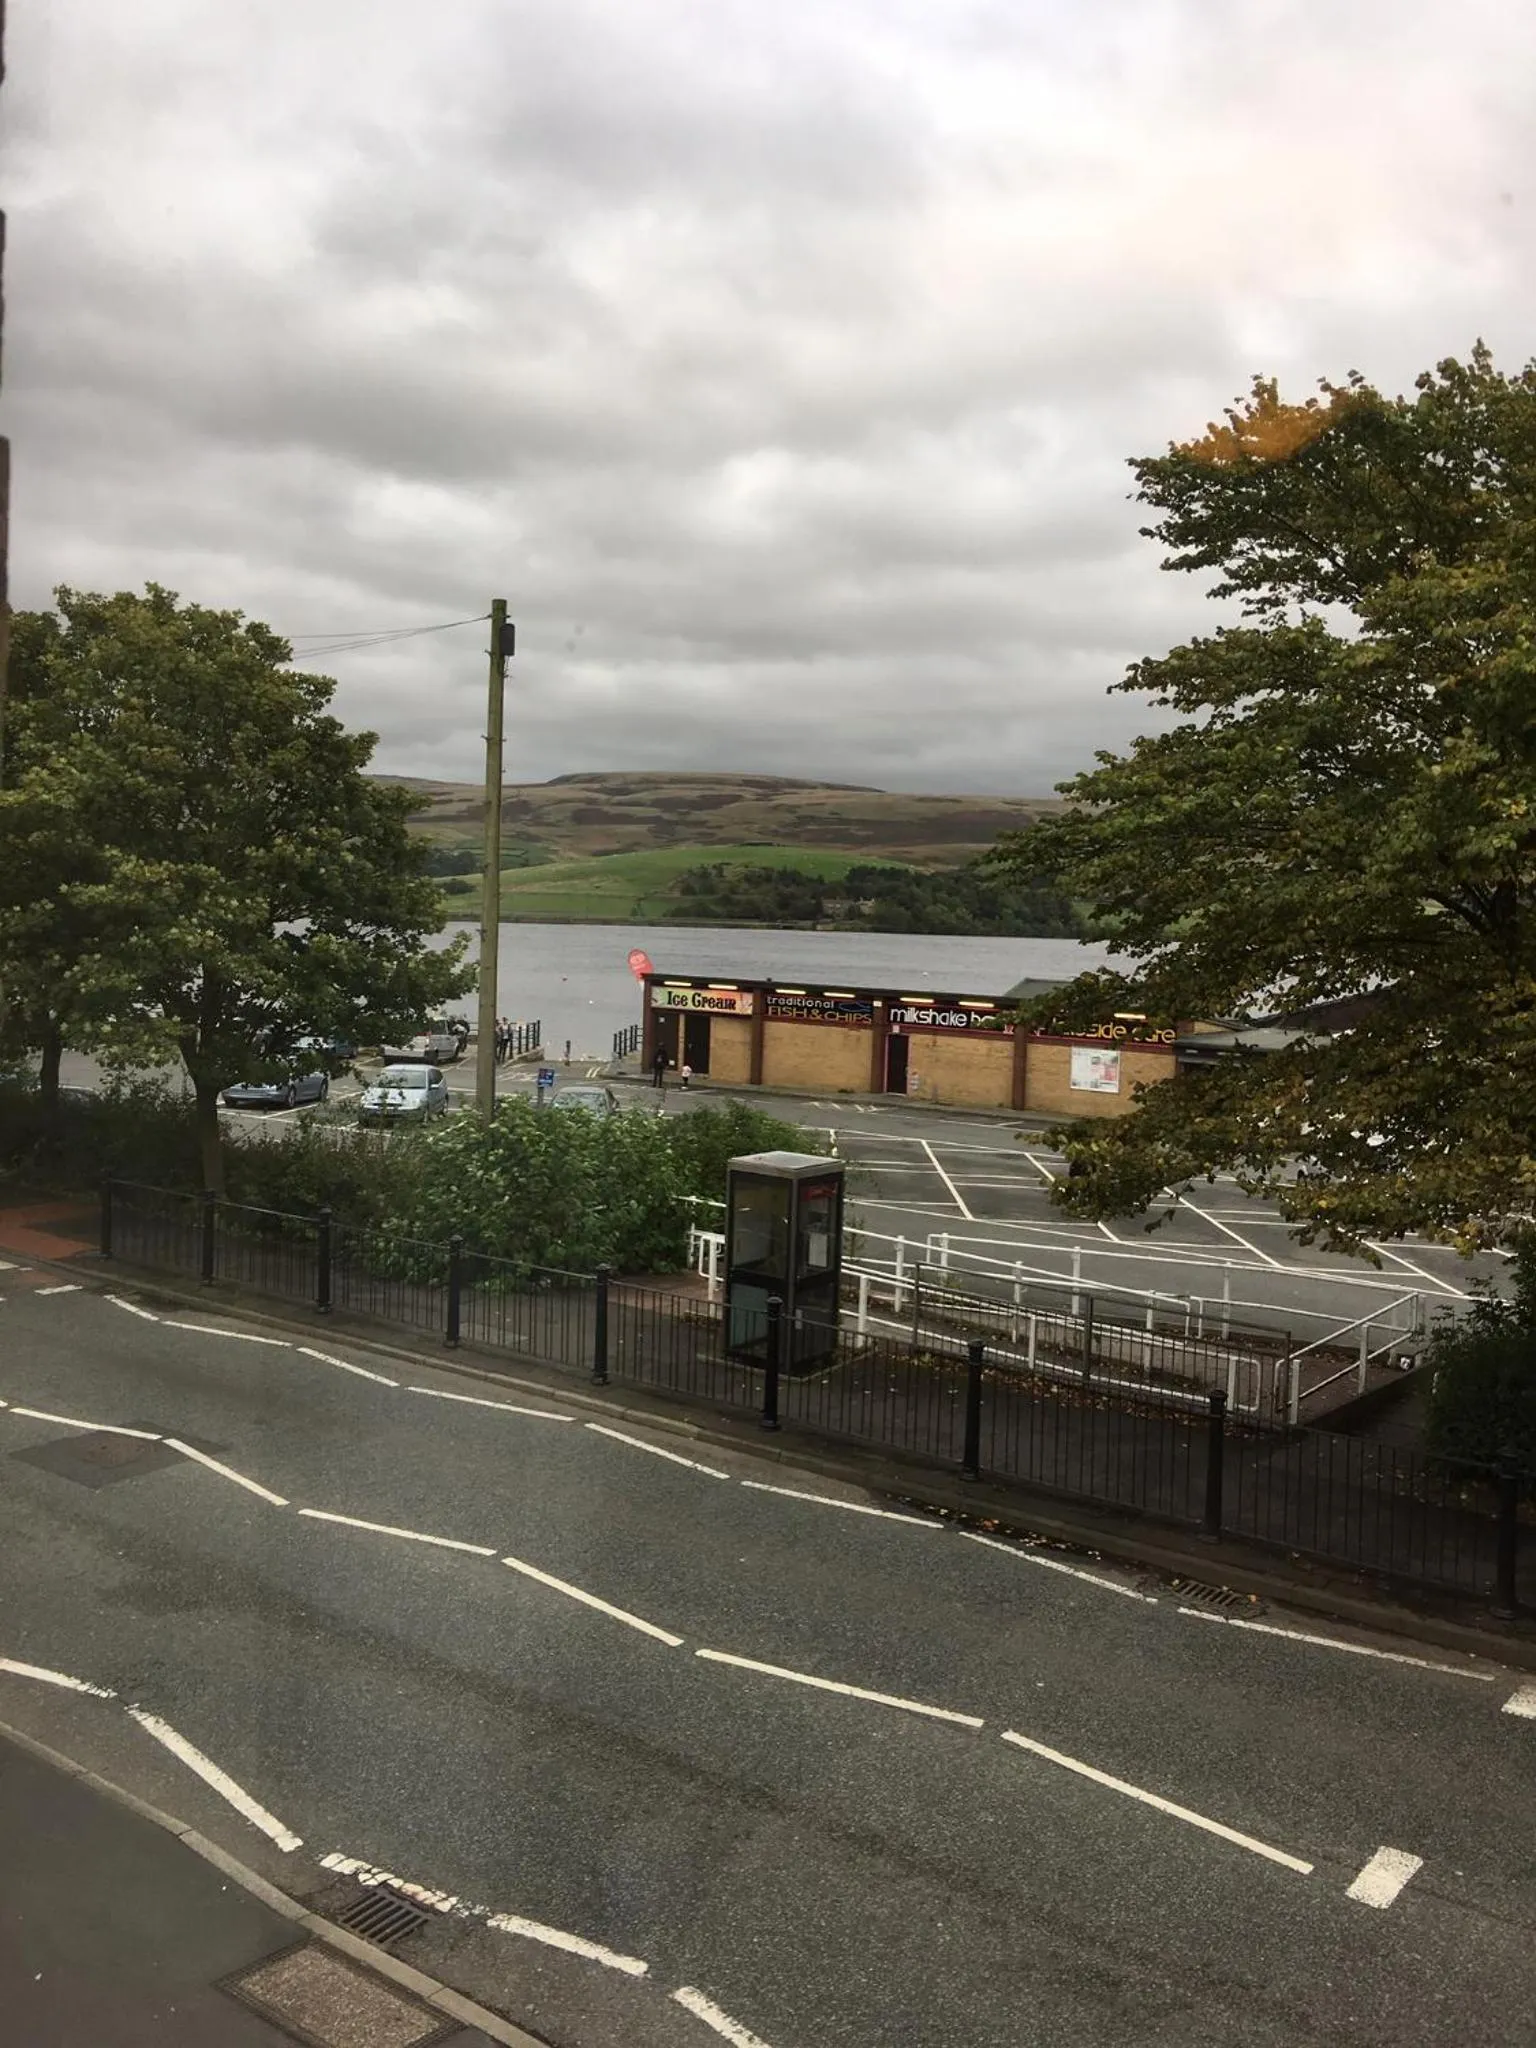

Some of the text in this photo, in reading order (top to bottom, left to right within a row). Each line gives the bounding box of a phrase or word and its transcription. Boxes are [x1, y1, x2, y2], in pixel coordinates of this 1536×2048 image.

[666, 990, 737, 1010] Ice Cream
[766, 996, 834, 1009] traditional
[767, 1006, 872, 1024] FISH & CHIPS
[889, 1006, 967, 1027] milkshake
